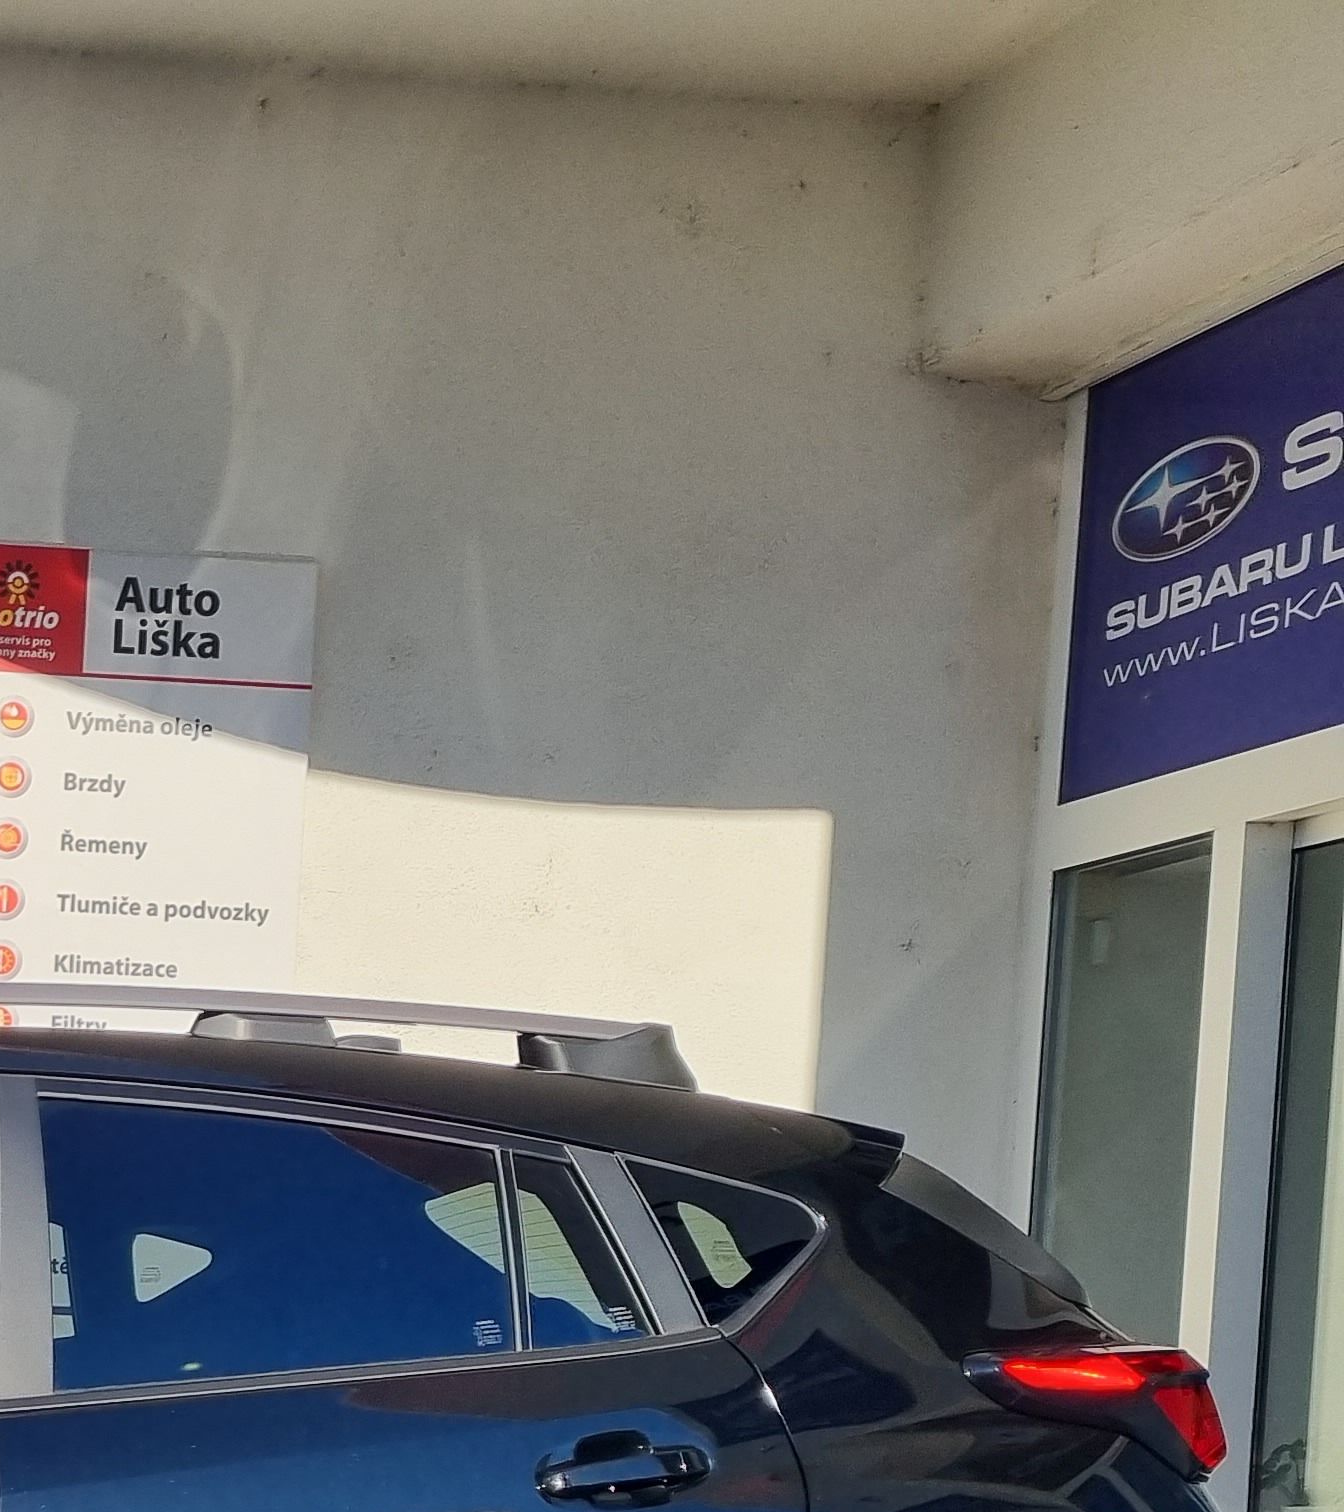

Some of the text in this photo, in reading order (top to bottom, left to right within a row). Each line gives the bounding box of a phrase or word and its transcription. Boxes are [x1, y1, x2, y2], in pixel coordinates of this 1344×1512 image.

[115, 576, 221, 617] Auto
[1106, 532, 1313, 641] SUBARU
[17, 648, 56, 661] značky
[32, 637, 52, 649] pro
[112, 619, 221, 660] Liška
[66, 710, 214, 742] Výměna oleje
[63, 772, 127, 798] Brzdy
[60, 829, 148, 861] Řemeny
[57, 893, 270, 928] Tlumiče a podvozky
[53, 953, 178, 979] Klimatizace
